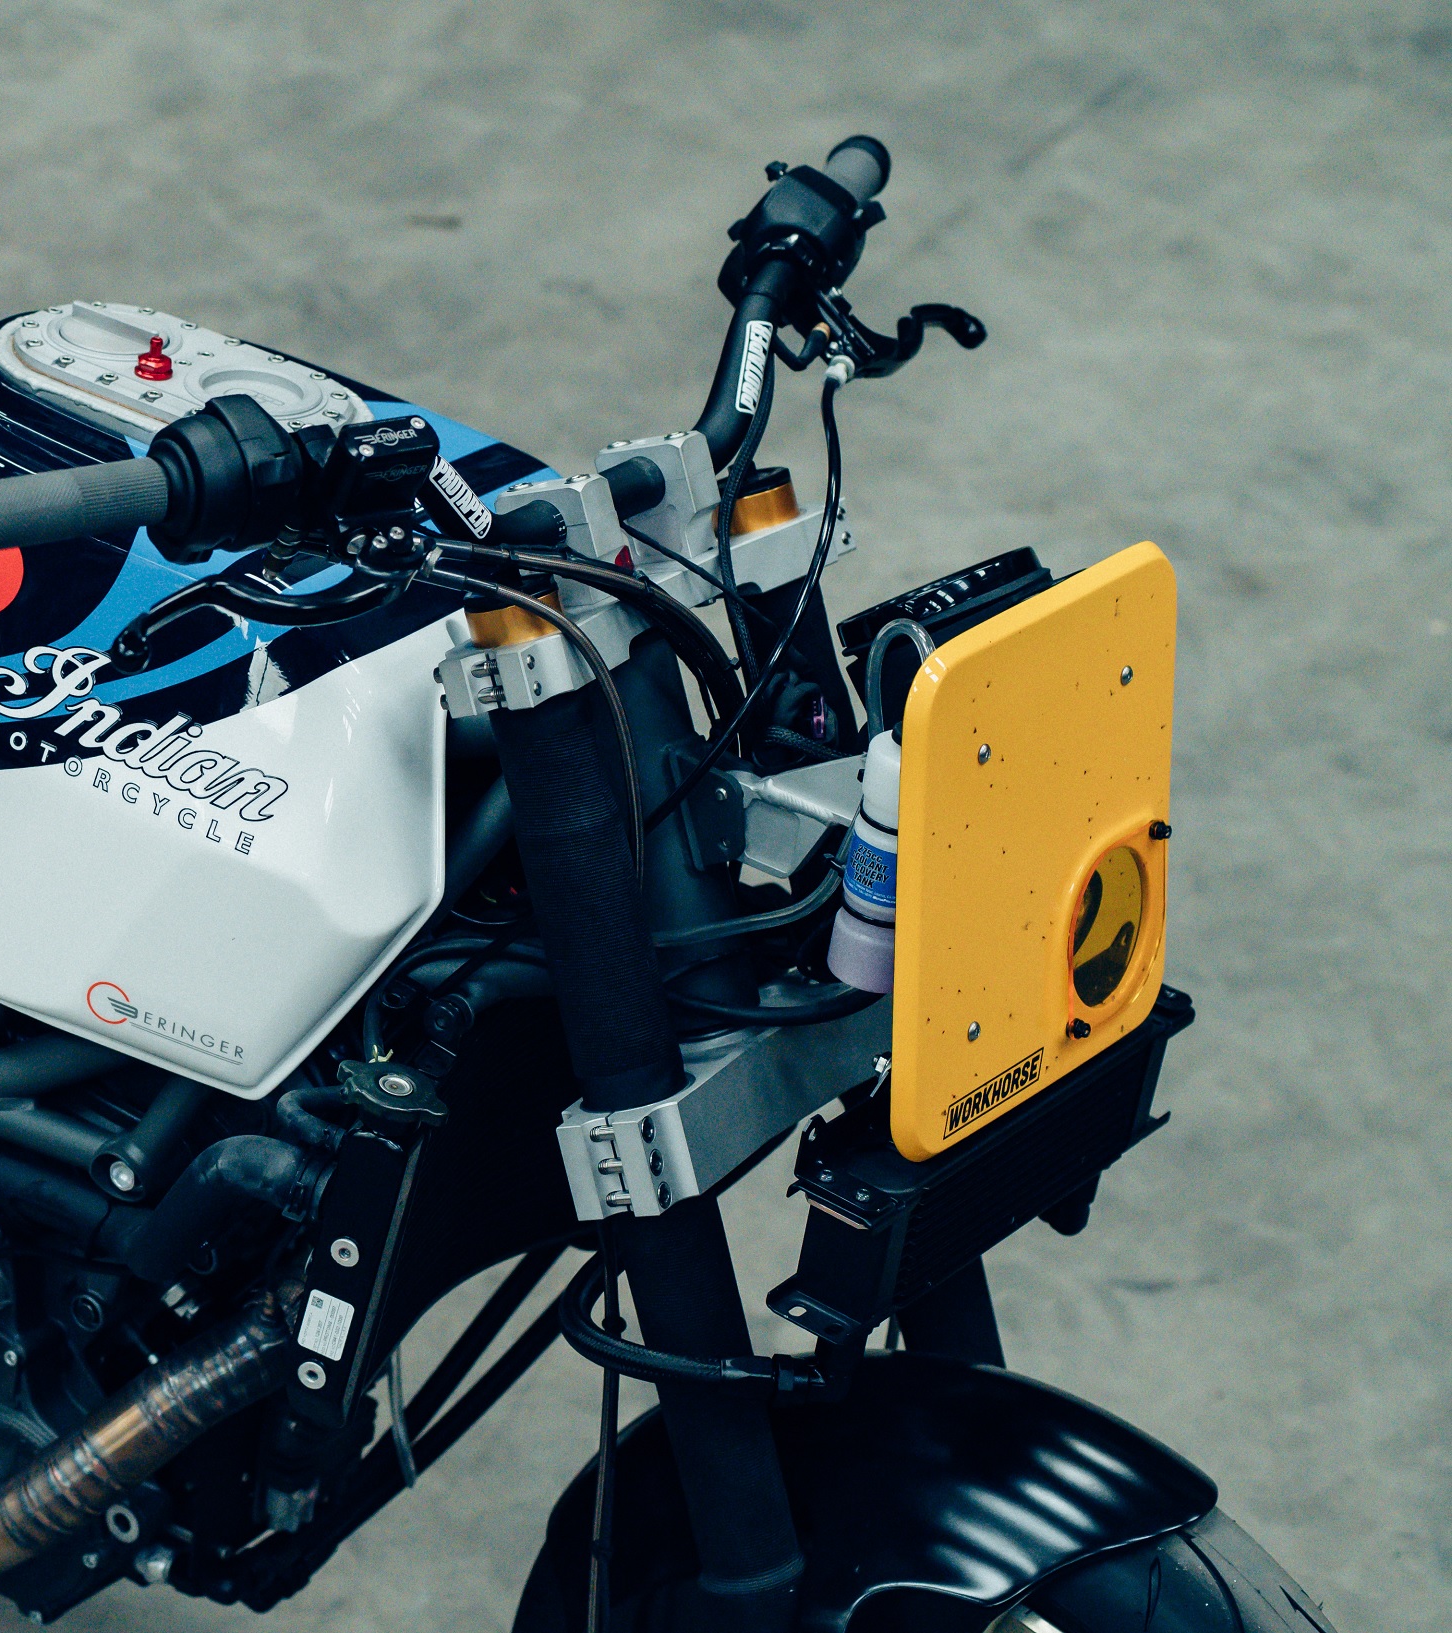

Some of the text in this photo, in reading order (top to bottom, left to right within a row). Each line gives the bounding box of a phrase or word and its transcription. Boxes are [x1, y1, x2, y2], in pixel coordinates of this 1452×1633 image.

[433, 457, 490, 531] PROTAPER
[851, 859, 891, 884] ECOVERY
[853, 871, 875, 889] TANK
[949, 1054, 1040, 1132] WORKHORSE
